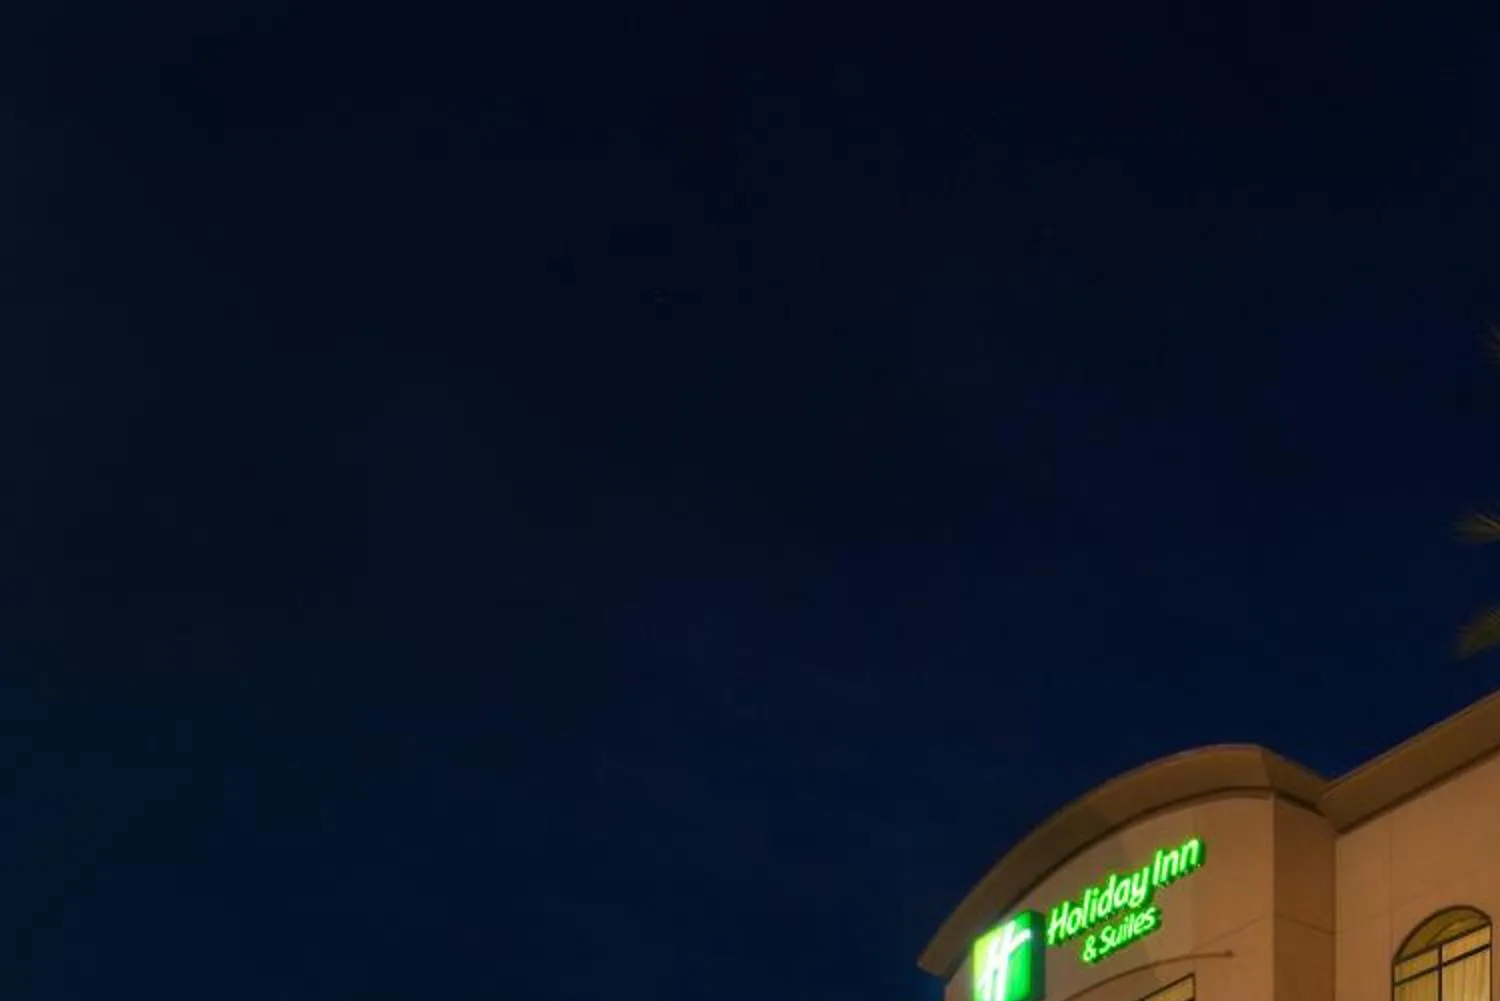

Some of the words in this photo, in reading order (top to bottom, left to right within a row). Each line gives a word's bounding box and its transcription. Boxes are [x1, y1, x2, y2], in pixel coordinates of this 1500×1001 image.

[1046, 865, 1152, 945] Holiday
[1151, 837, 1202, 887] Inn
[1081, 935, 1098, 963] &
[1099, 905, 1158, 954] Suites
